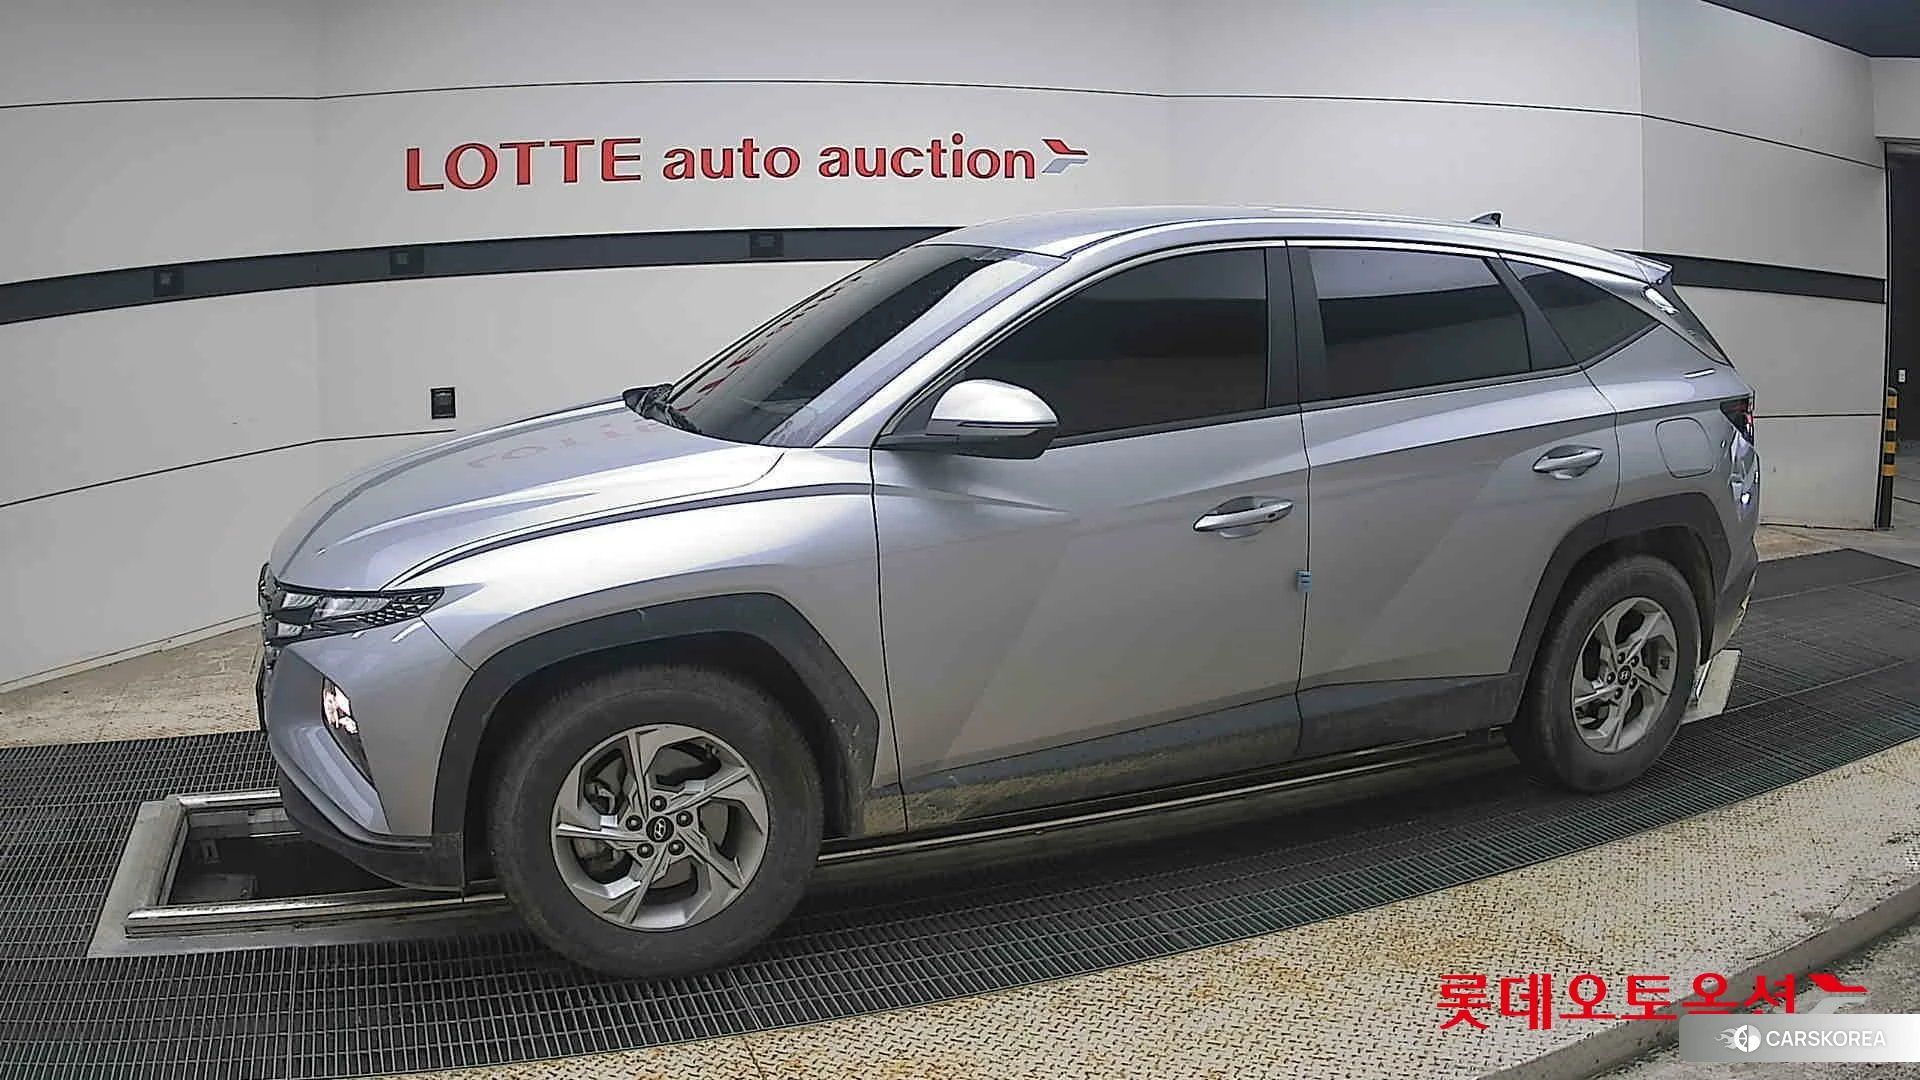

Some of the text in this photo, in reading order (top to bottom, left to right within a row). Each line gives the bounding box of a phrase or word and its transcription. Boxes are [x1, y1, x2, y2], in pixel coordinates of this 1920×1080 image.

[406, 132, 1036, 191] LOTTE auto auction
